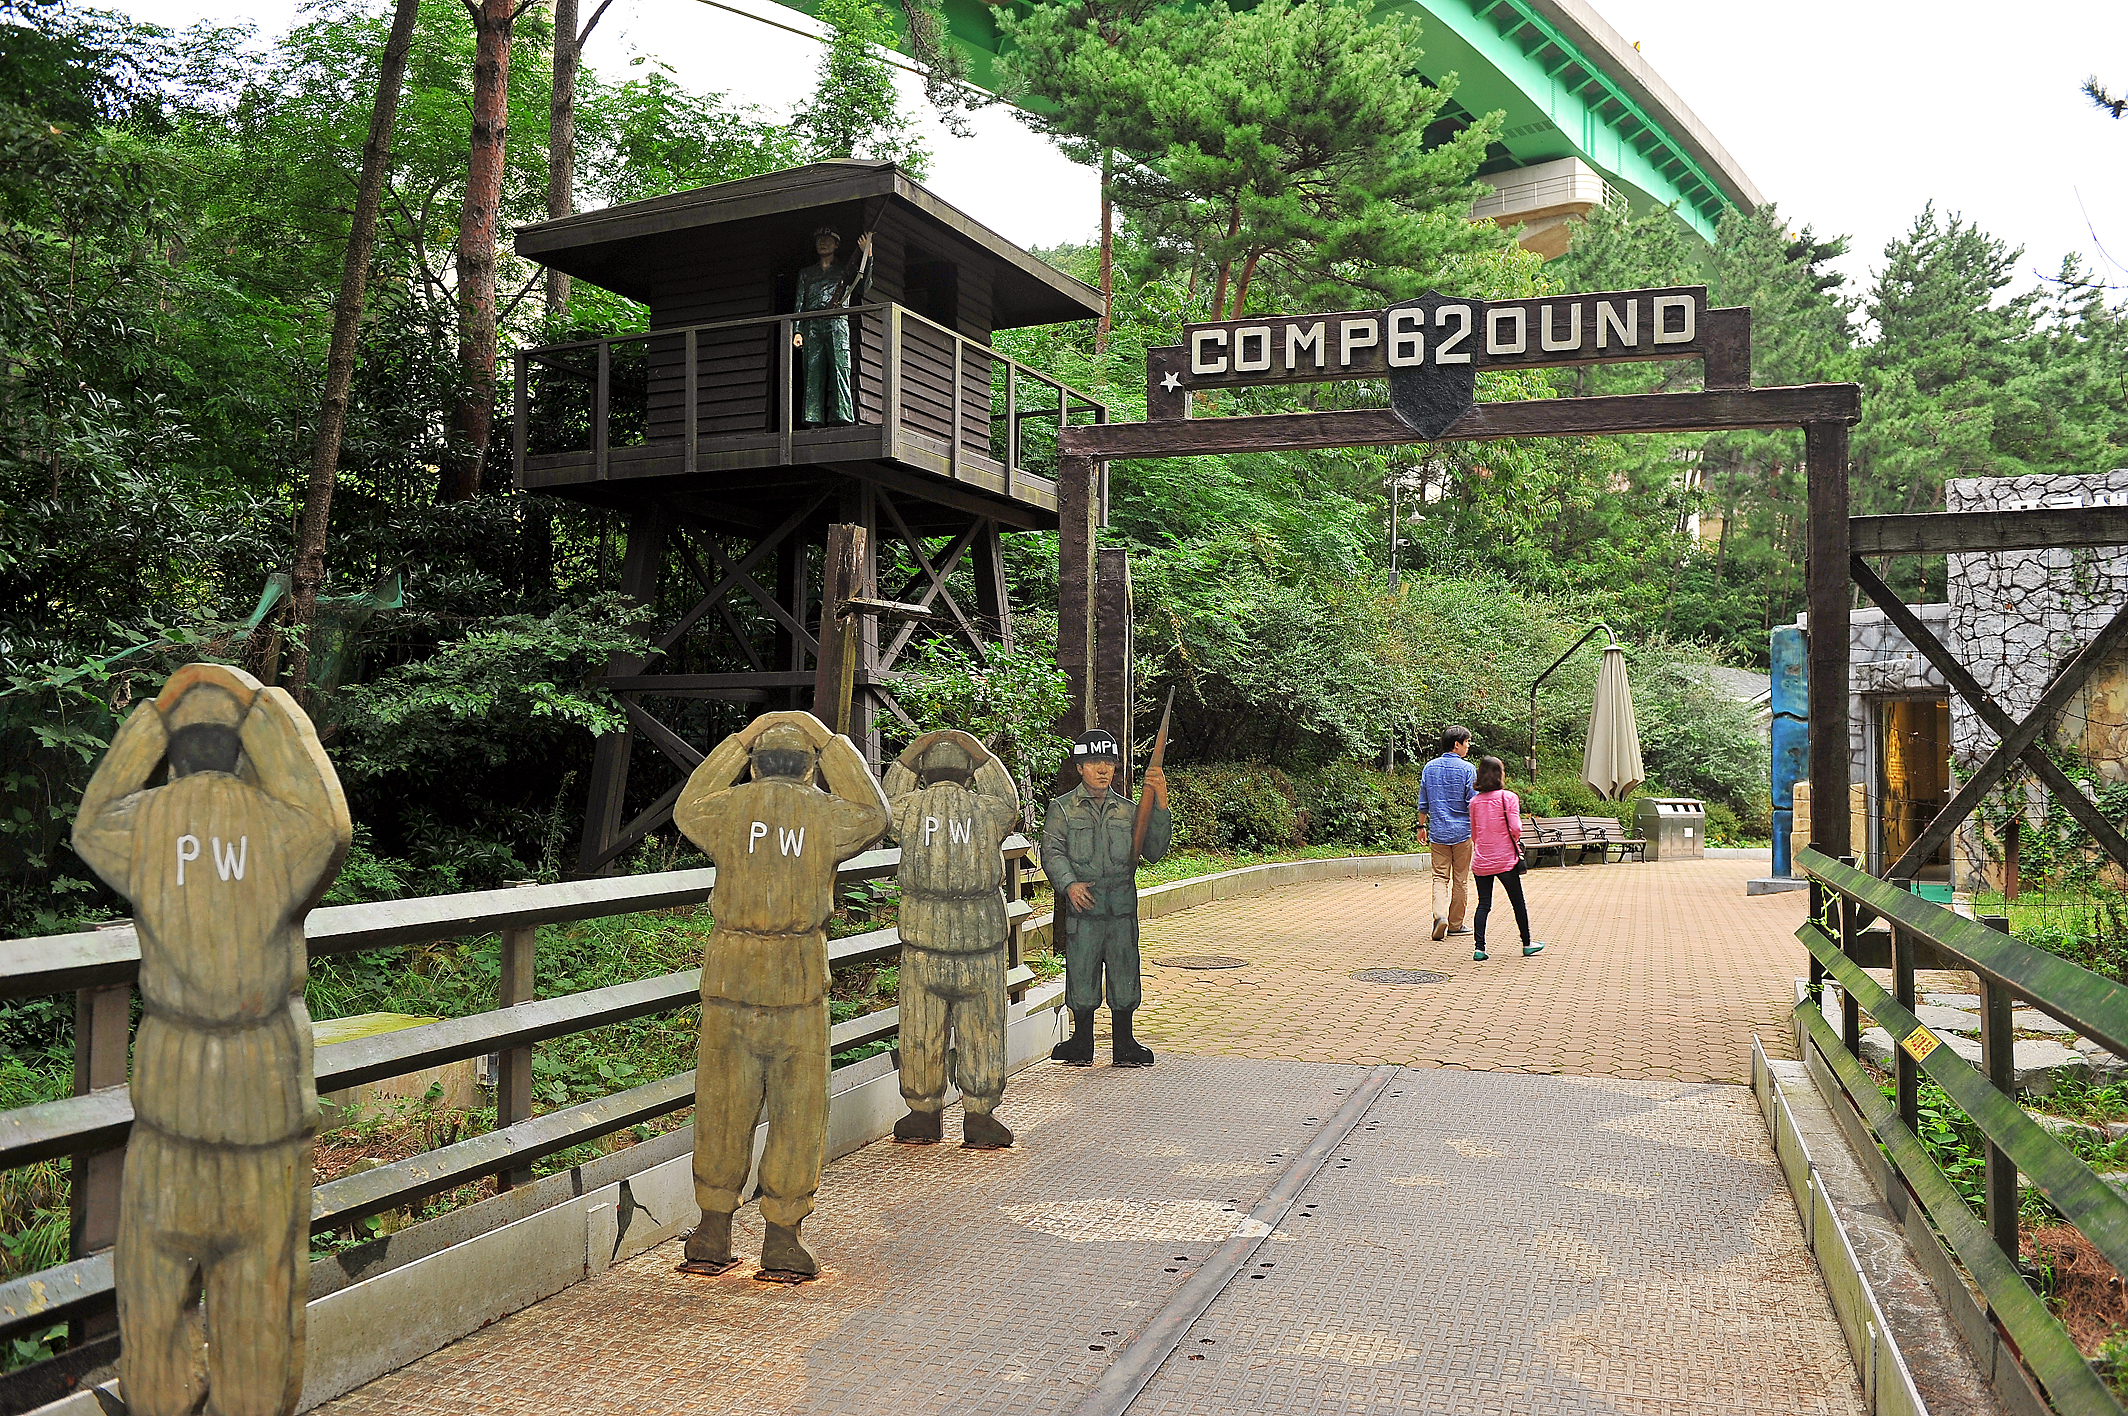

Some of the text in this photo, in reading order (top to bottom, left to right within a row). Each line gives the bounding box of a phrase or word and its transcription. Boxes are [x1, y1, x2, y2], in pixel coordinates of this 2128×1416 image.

[1090, 740, 1112, 754] MP
[748, 820, 805, 858] PW
[925, 815, 972, 847] PW
[176, 834, 248, 886] PW
